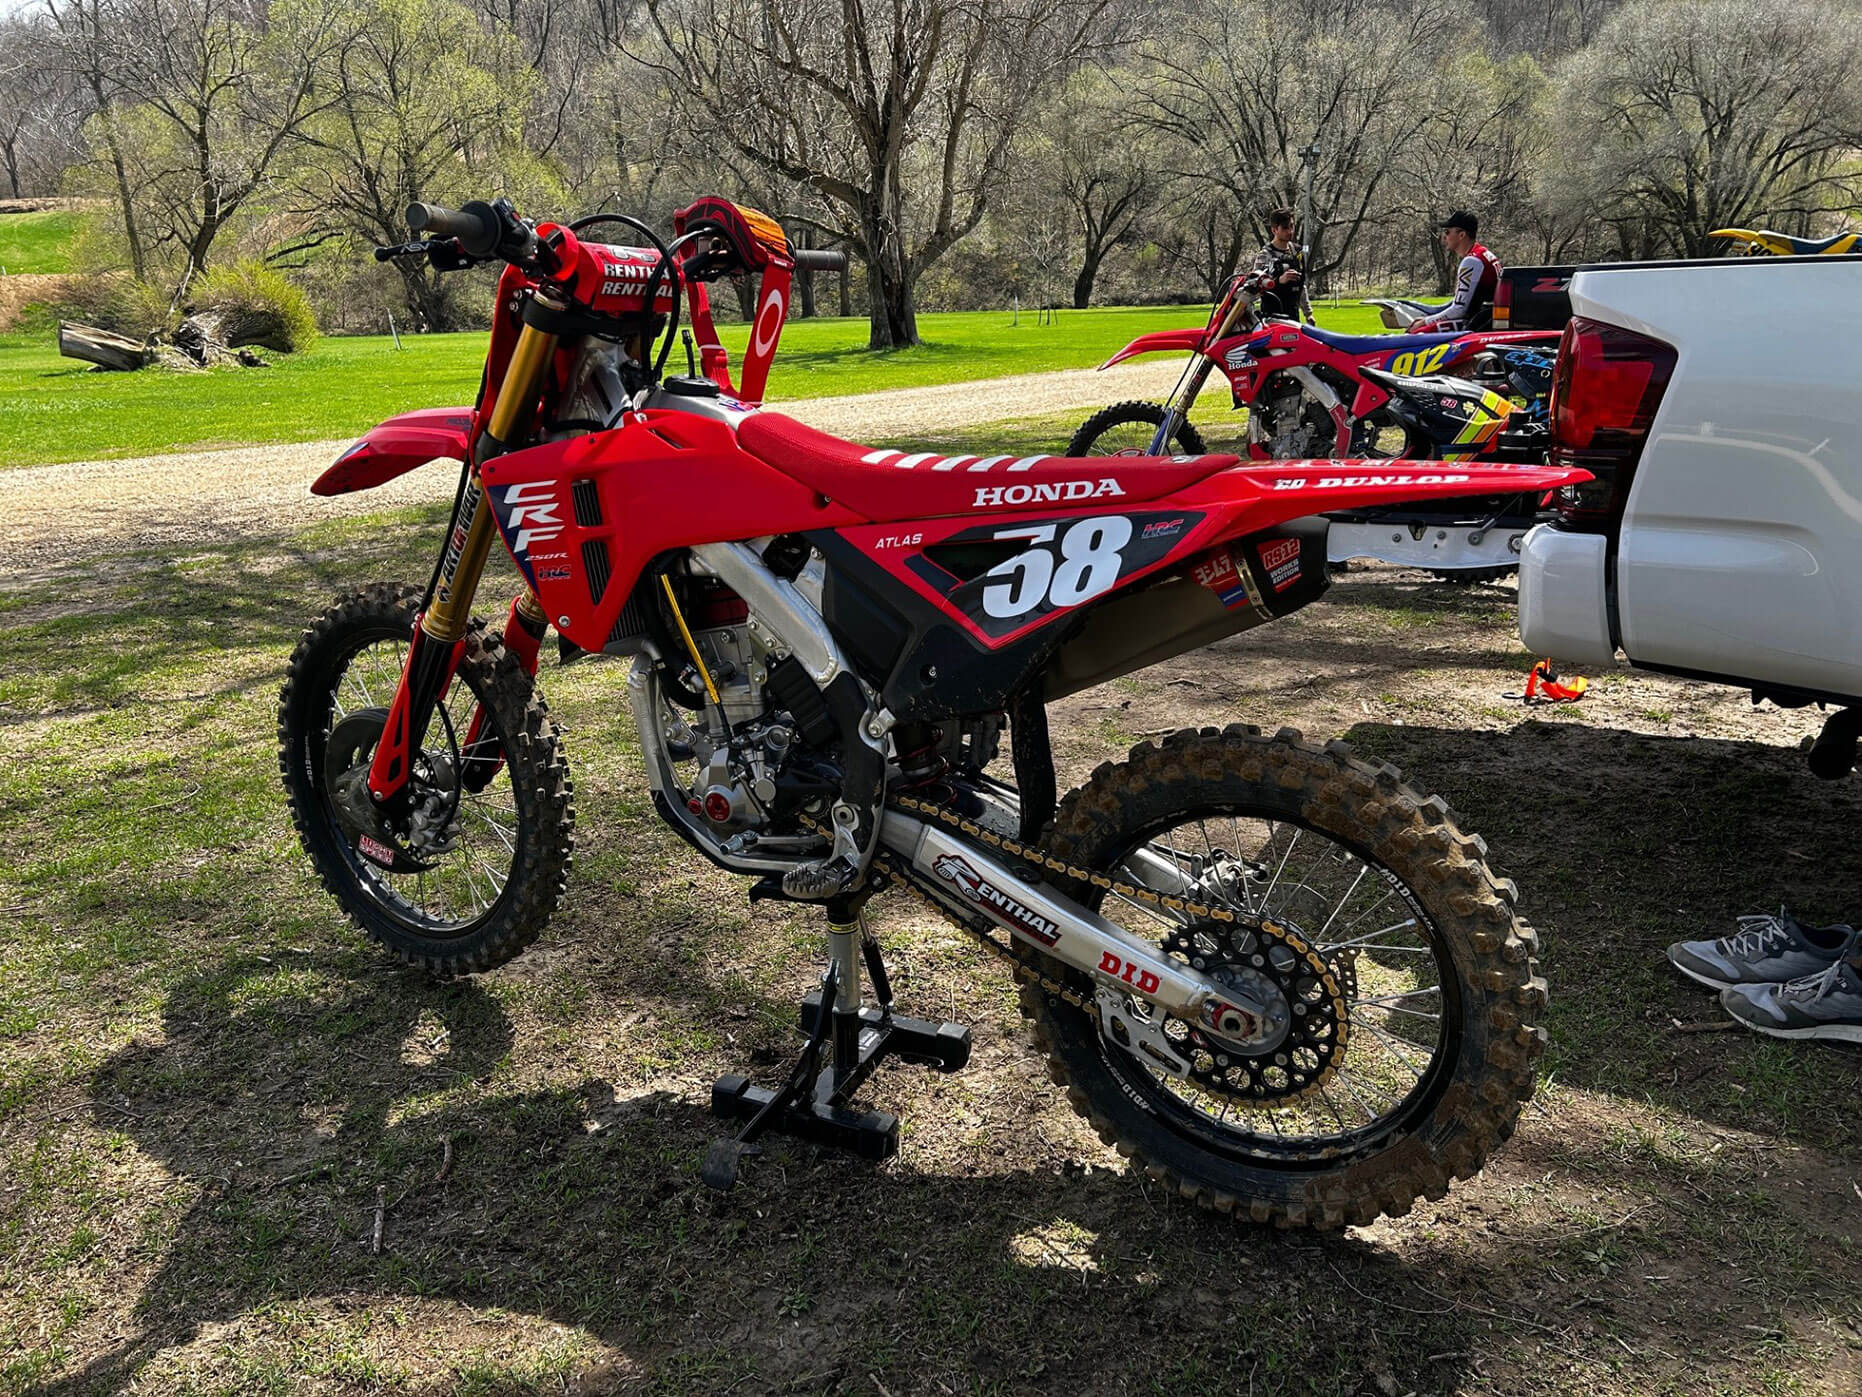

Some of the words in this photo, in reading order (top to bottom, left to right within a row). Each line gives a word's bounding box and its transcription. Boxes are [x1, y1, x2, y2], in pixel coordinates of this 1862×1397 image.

[1228, 360, 1259, 371] Honda
[1391, 343, 1451, 377] 912
[1312, 475, 1469, 489] DUNLOP
[972, 478, 1126, 507] HONDA
[1141, 519, 1185, 539] HRC
[875, 533, 923, 550] ATLAS
[982, 515, 1133, 618] 58
[1270, 558, 1299, 578] WORKS
[1272, 566, 1300, 584] EDITION
